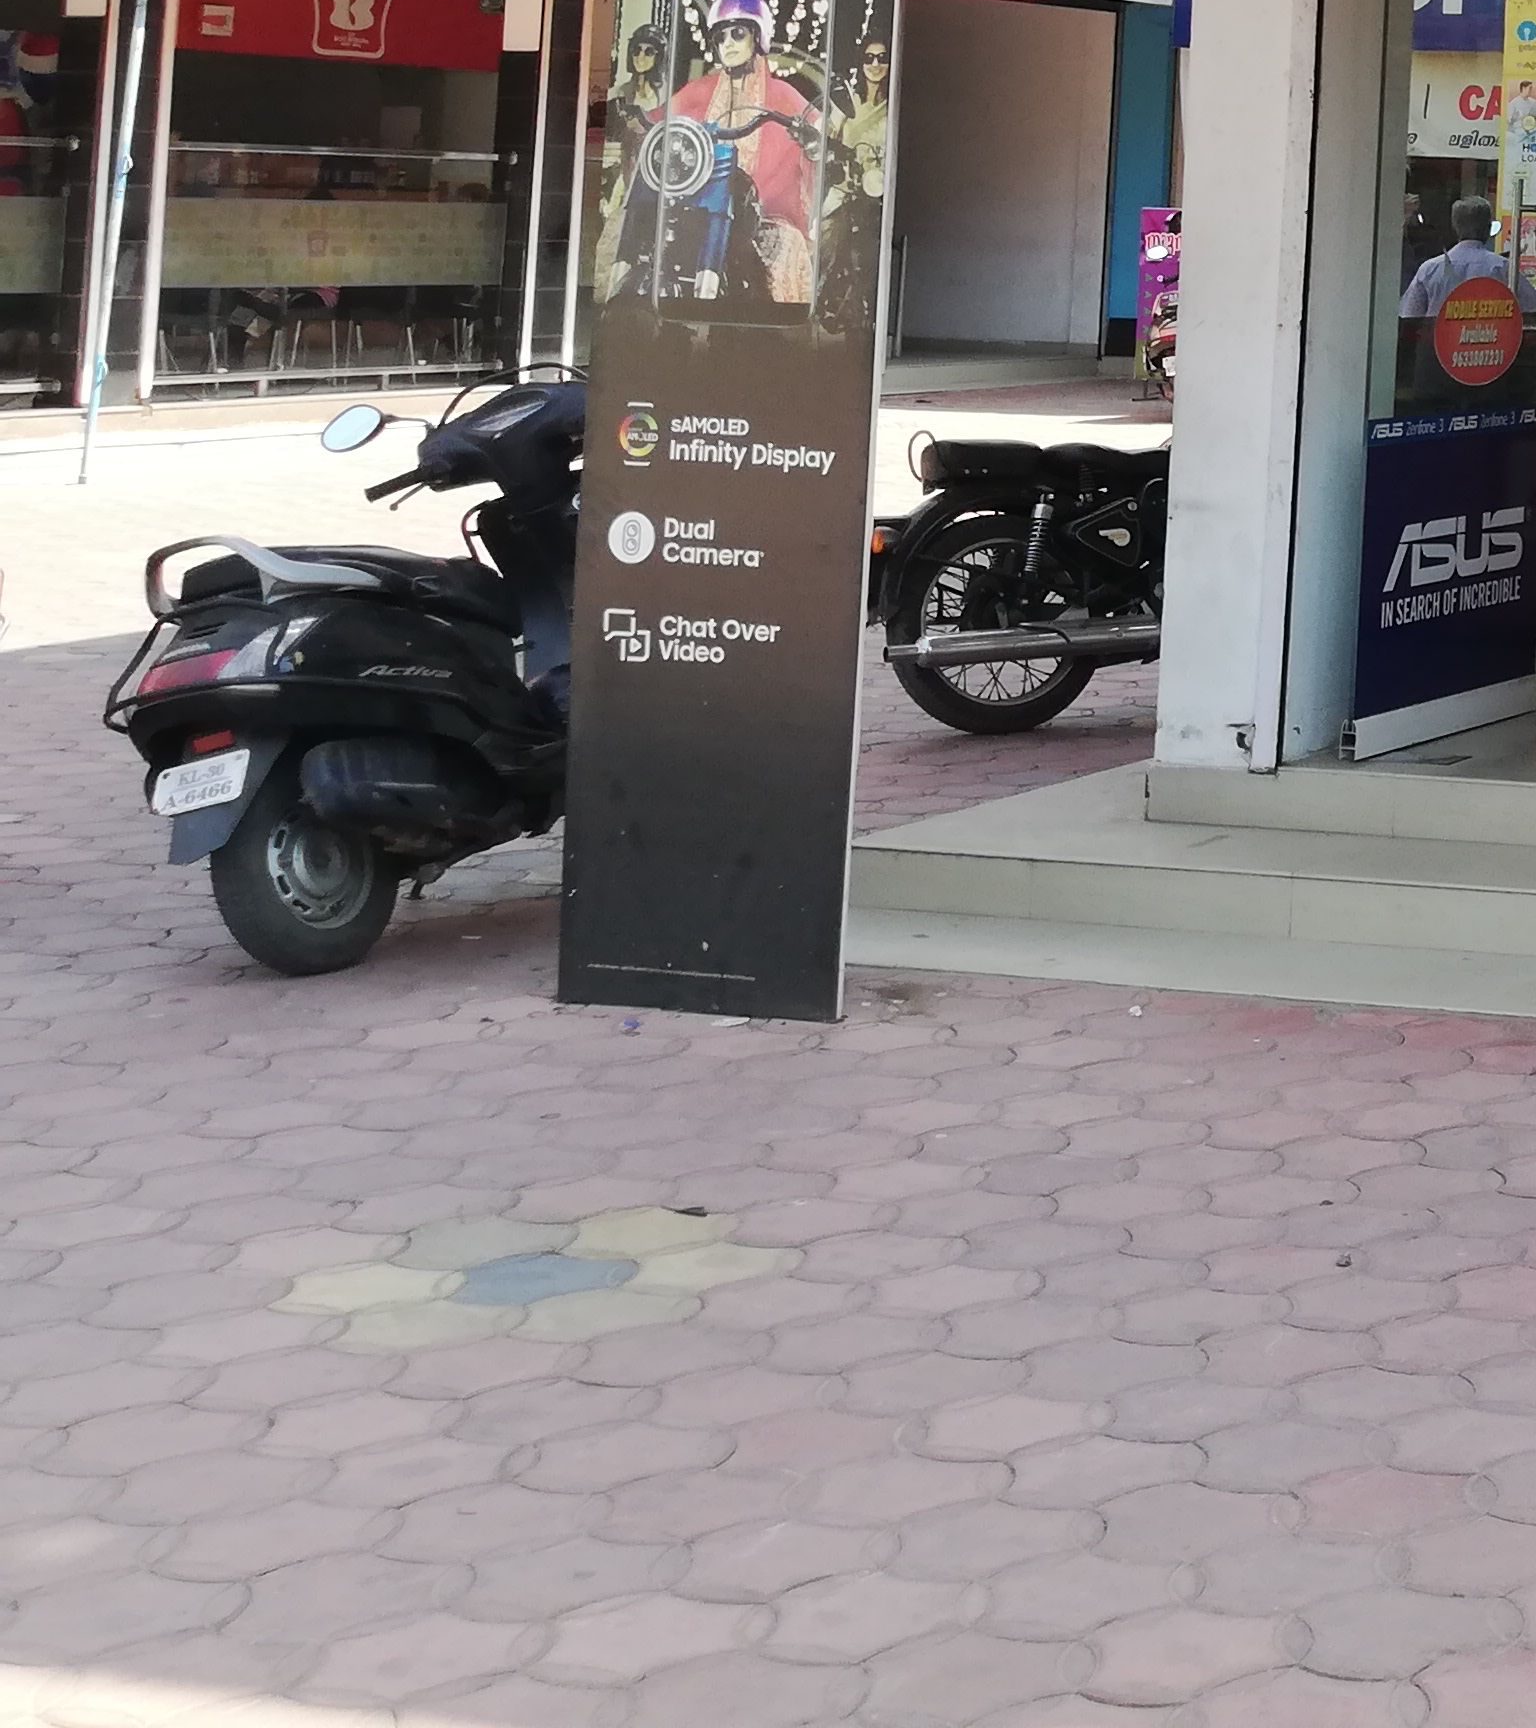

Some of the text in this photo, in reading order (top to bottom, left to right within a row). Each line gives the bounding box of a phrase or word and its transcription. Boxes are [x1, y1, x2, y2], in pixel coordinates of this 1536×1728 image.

[670, 416, 750, 437] sAMOLED
[1371, 422, 1403, 440] ASUS
[1405, 421, 1437, 438] Zenfone
[1438, 420, 1444, 434] 3
[1448, 415, 1478, 432] ASUS
[668, 439, 836, 475] Infinity Display
[663, 517, 715, 541] Dual
[1382, 506, 1526, 593] ASUS
[1380, 575, 1522, 630] IN SEARCH OF INCREDIBLE
[659, 615, 781, 643] Chat Over
[659, 639, 725, 664] Video
